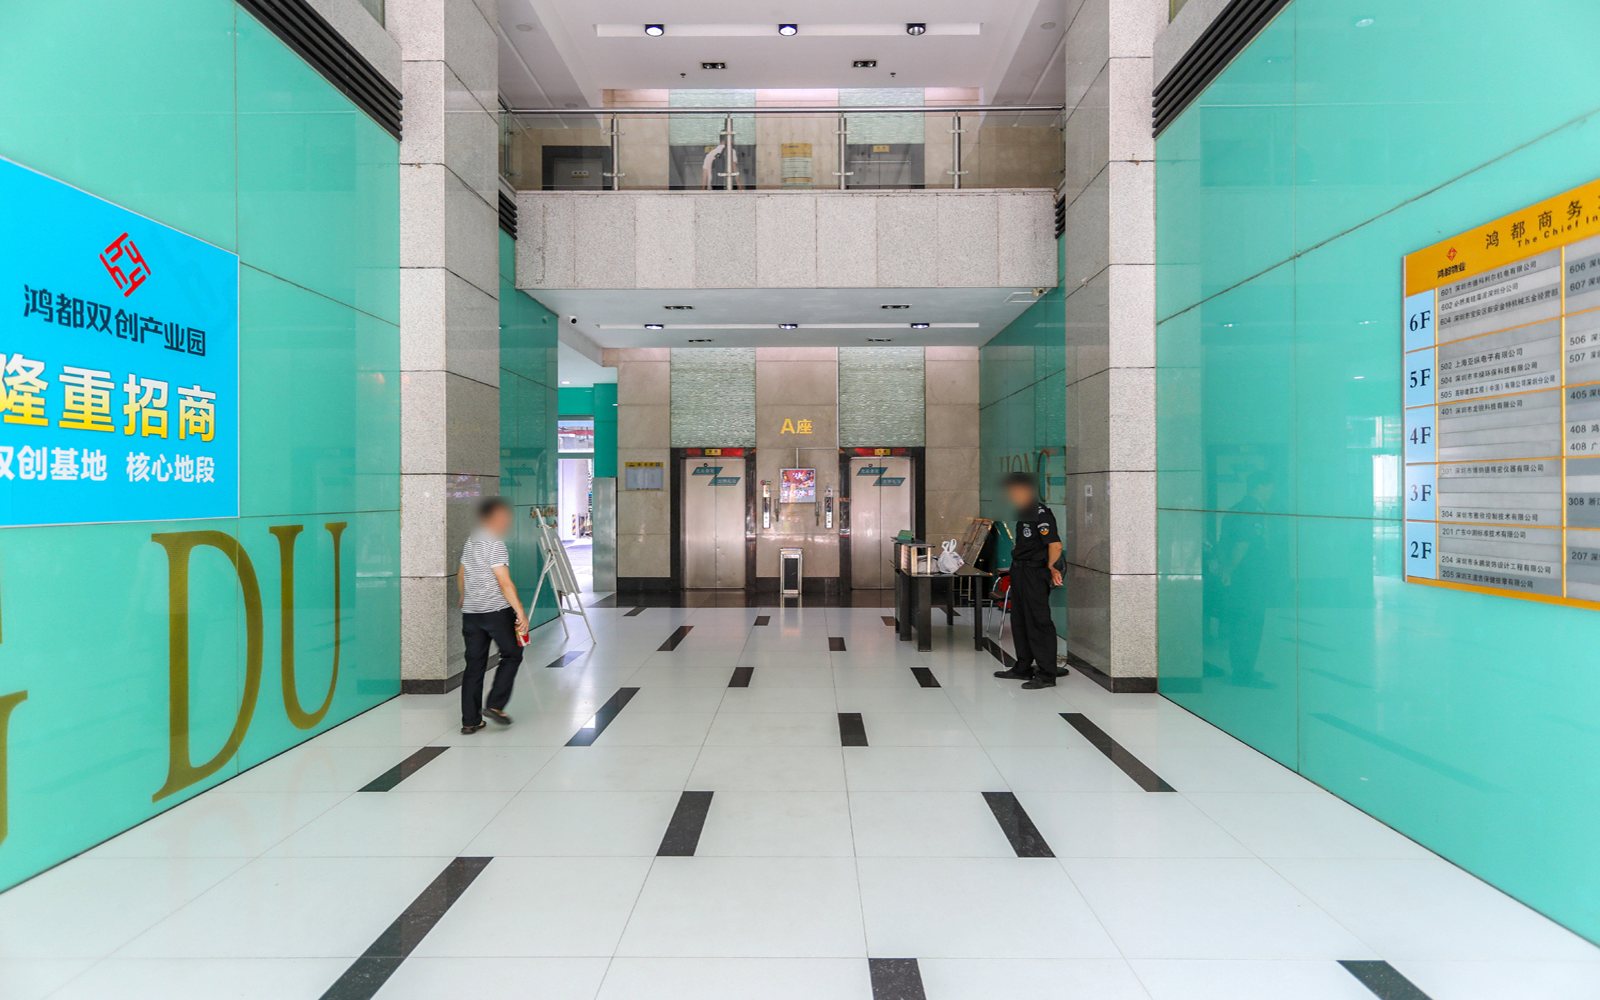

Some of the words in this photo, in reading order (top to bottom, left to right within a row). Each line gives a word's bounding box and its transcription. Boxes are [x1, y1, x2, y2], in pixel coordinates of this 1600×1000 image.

[1485, 196, 1600, 249] 鸿都商务
[1517, 236, 1538, 248] The
[1544, 220, 1579, 239] Chief
[1569, 262, 1586, 274] 606
[1569, 279, 1586, 292] 607
[1440, 287, 1453, 297] 601
[1441, 302, 1453, 311] 602
[23, 284, 206, 357] 鸿都双创产业园
[1409, 310, 1431, 331] 6F
[1440, 316, 1452, 326] 604
[1569, 335, 1586, 346] 506
[1569, 352, 1586, 363] 507
[1440, 361, 1453, 371] 502
[1409, 368, 1431, 388] 5F
[1440, 376, 1453, 385] 504
[0, 353, 217, 443] 隆重招商
[1440, 389, 1453, 399] 505
[1570, 390, 1587, 400] 405
[1441, 407, 1453, 416] 401
[780, 418, 812, 435] A座
[1570, 424, 1587, 434] 408
[1409, 426, 1432, 444] 4F
[1570, 442, 1587, 451] 408
[126, 451, 216, 483] 核心地段
[1410, 484, 1432, 502] 3F
[1568, 497, 1585, 506] 308
[1441, 510, 1453, 518] 304
[1442, 528, 1454, 536] 201
[1410, 540, 1432, 559] 2F
[1441, 555, 1454, 564] 204
[1571, 551, 1588, 561] 207
[1442, 570, 1455, 579] 205
[151, 521, 348, 804] DU
